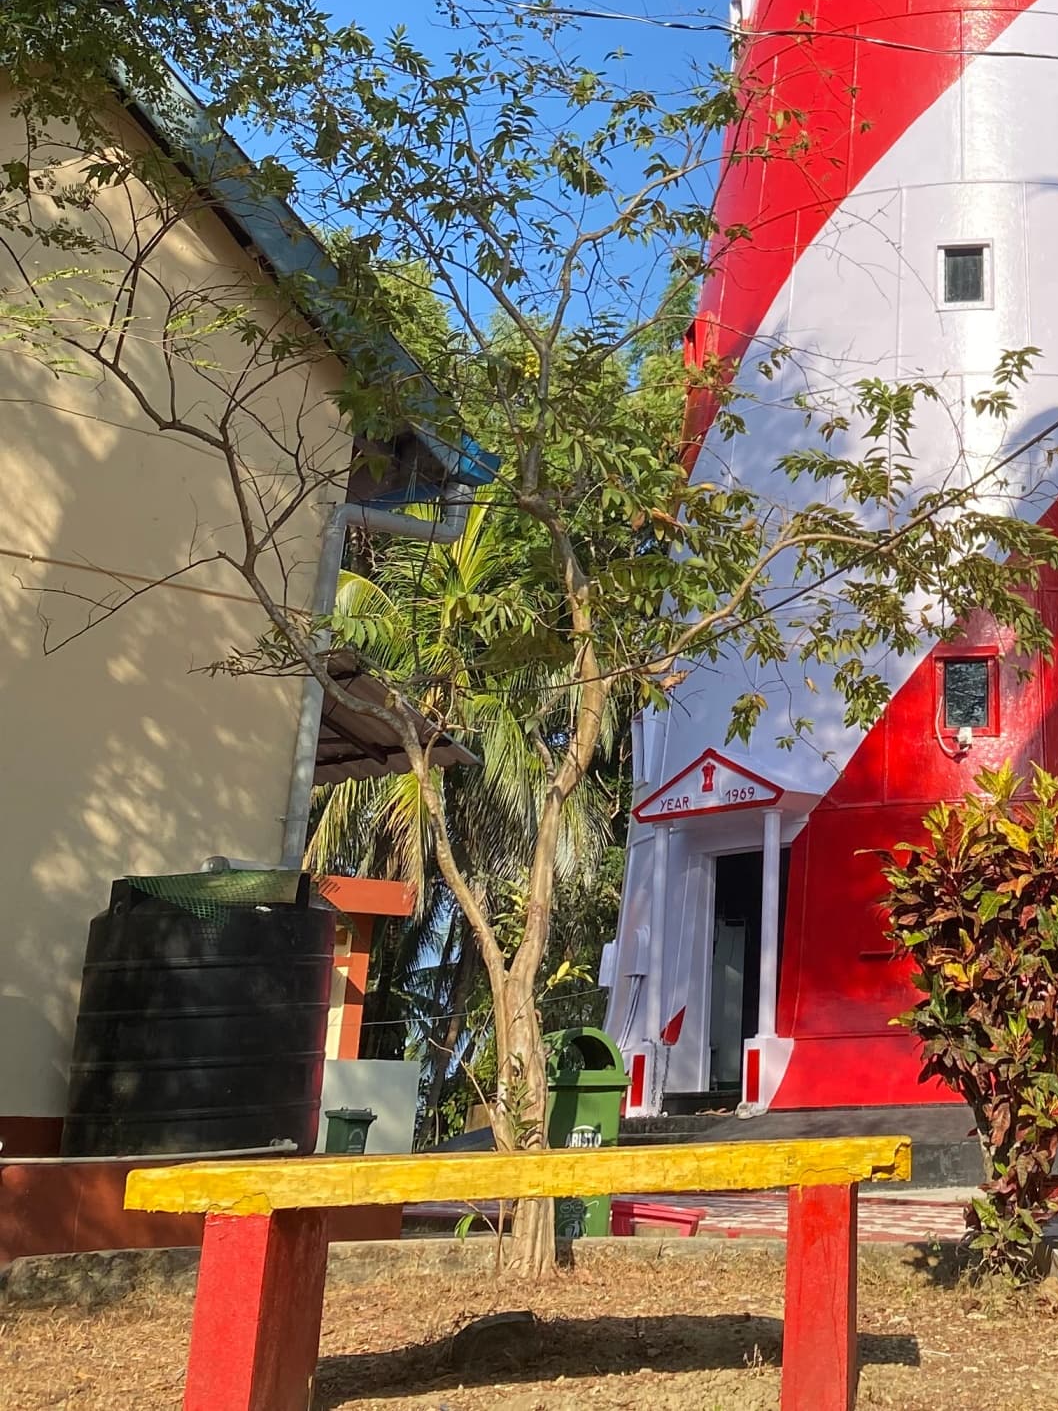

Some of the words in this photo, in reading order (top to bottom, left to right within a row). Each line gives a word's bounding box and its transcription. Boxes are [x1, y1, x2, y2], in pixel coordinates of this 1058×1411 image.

[660, 796, 689, 812] YEAR
[725, 786, 755, 802] 1969
[565, 1132, 602, 1148] ARISTO
